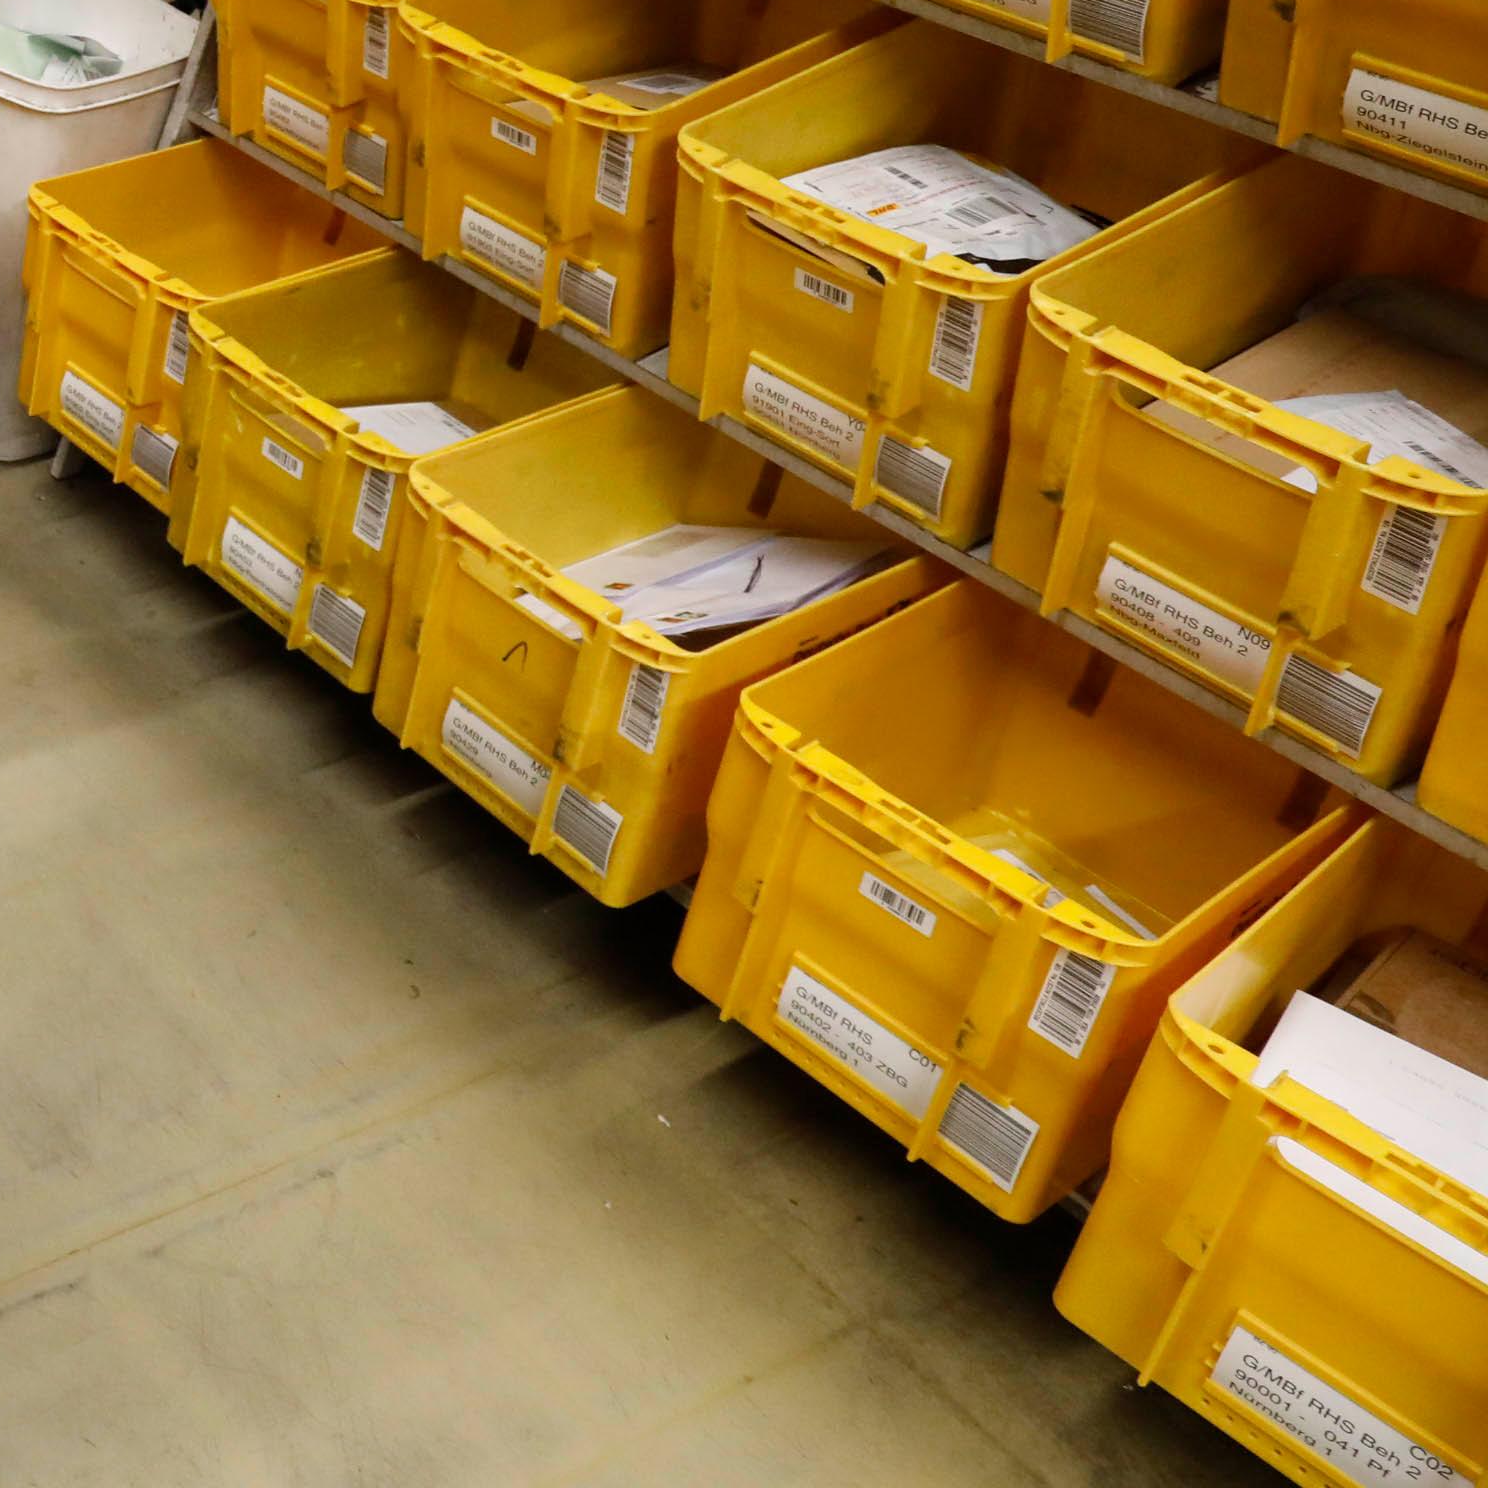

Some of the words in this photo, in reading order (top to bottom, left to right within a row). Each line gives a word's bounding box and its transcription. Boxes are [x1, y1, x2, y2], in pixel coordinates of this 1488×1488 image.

[1357, 106, 1406, 129] 90411
[1360, 90, 1414, 114] G/MBf
[1418, 108, 1459, 129] RHS
[1164, 604, 1199, 630] RHS
[1202, 625, 1233, 648] Beh
[1237, 645, 1248, 656] 2
[840, 1017, 872, 1045] RHS
[876, 1060, 908, 1088] ZBG
[908, 1048, 937, 1073] C01
[1235, 1368, 1292, 1412] 90001
[1323, 1430, 1358, 1458] 041
[1367, 1458, 1389, 1478] Pf
[1242, 1354, 1305, 1399] G/MBf
[1308, 1397, 1356, 1435] RHS
[1360, 1433, 1401, 1466] Beh
[1405, 1466, 1421, 1480] 2
[1409, 1445, 1454, 1481] C02
